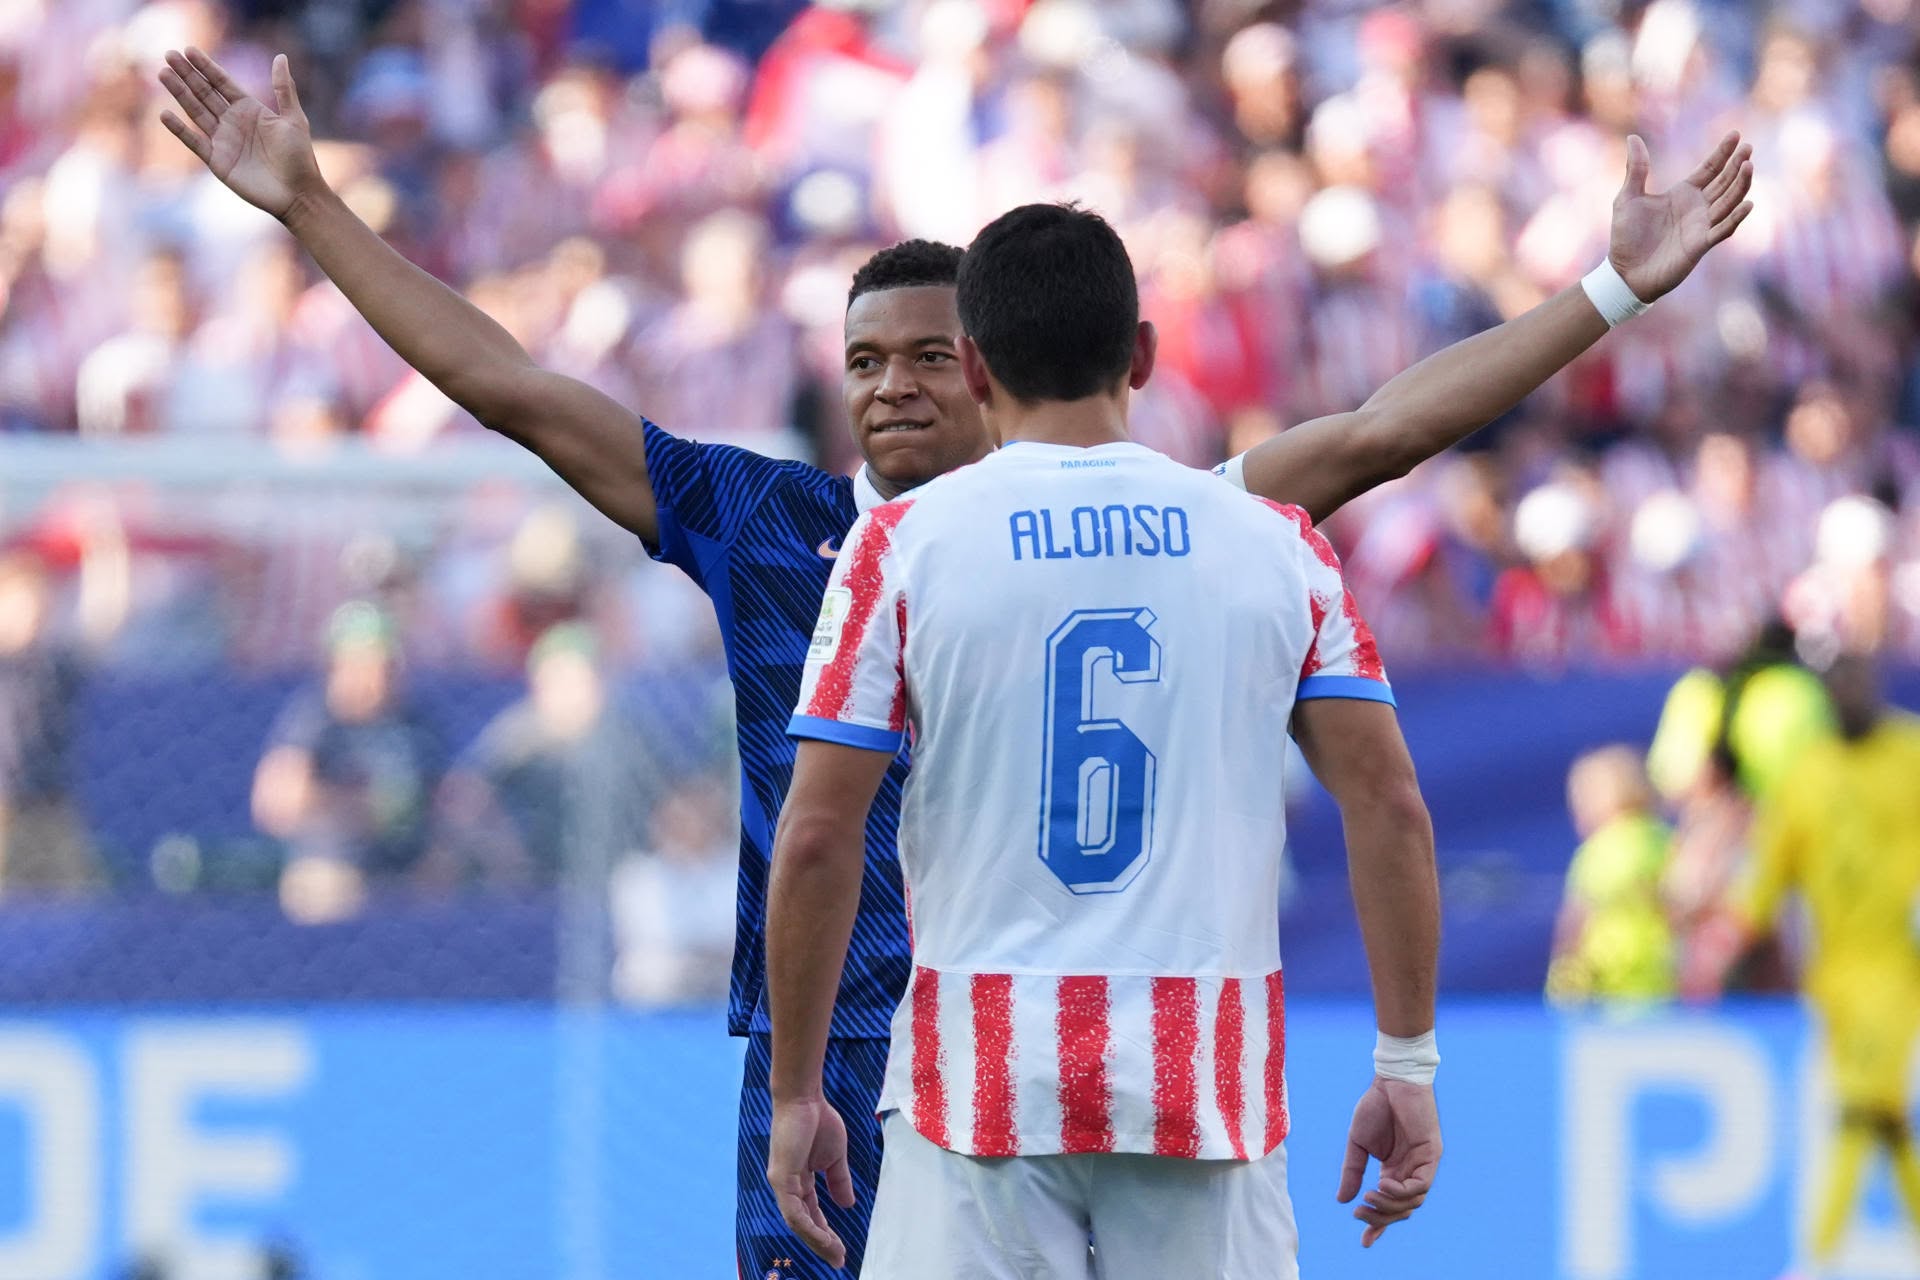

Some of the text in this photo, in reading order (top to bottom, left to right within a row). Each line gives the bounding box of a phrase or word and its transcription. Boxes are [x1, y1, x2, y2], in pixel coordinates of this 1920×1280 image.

[1060, 458, 1117, 469] PARAGUAY
[1009, 504, 1191, 560] ALONSO
[1038, 607, 1161, 896] 6
